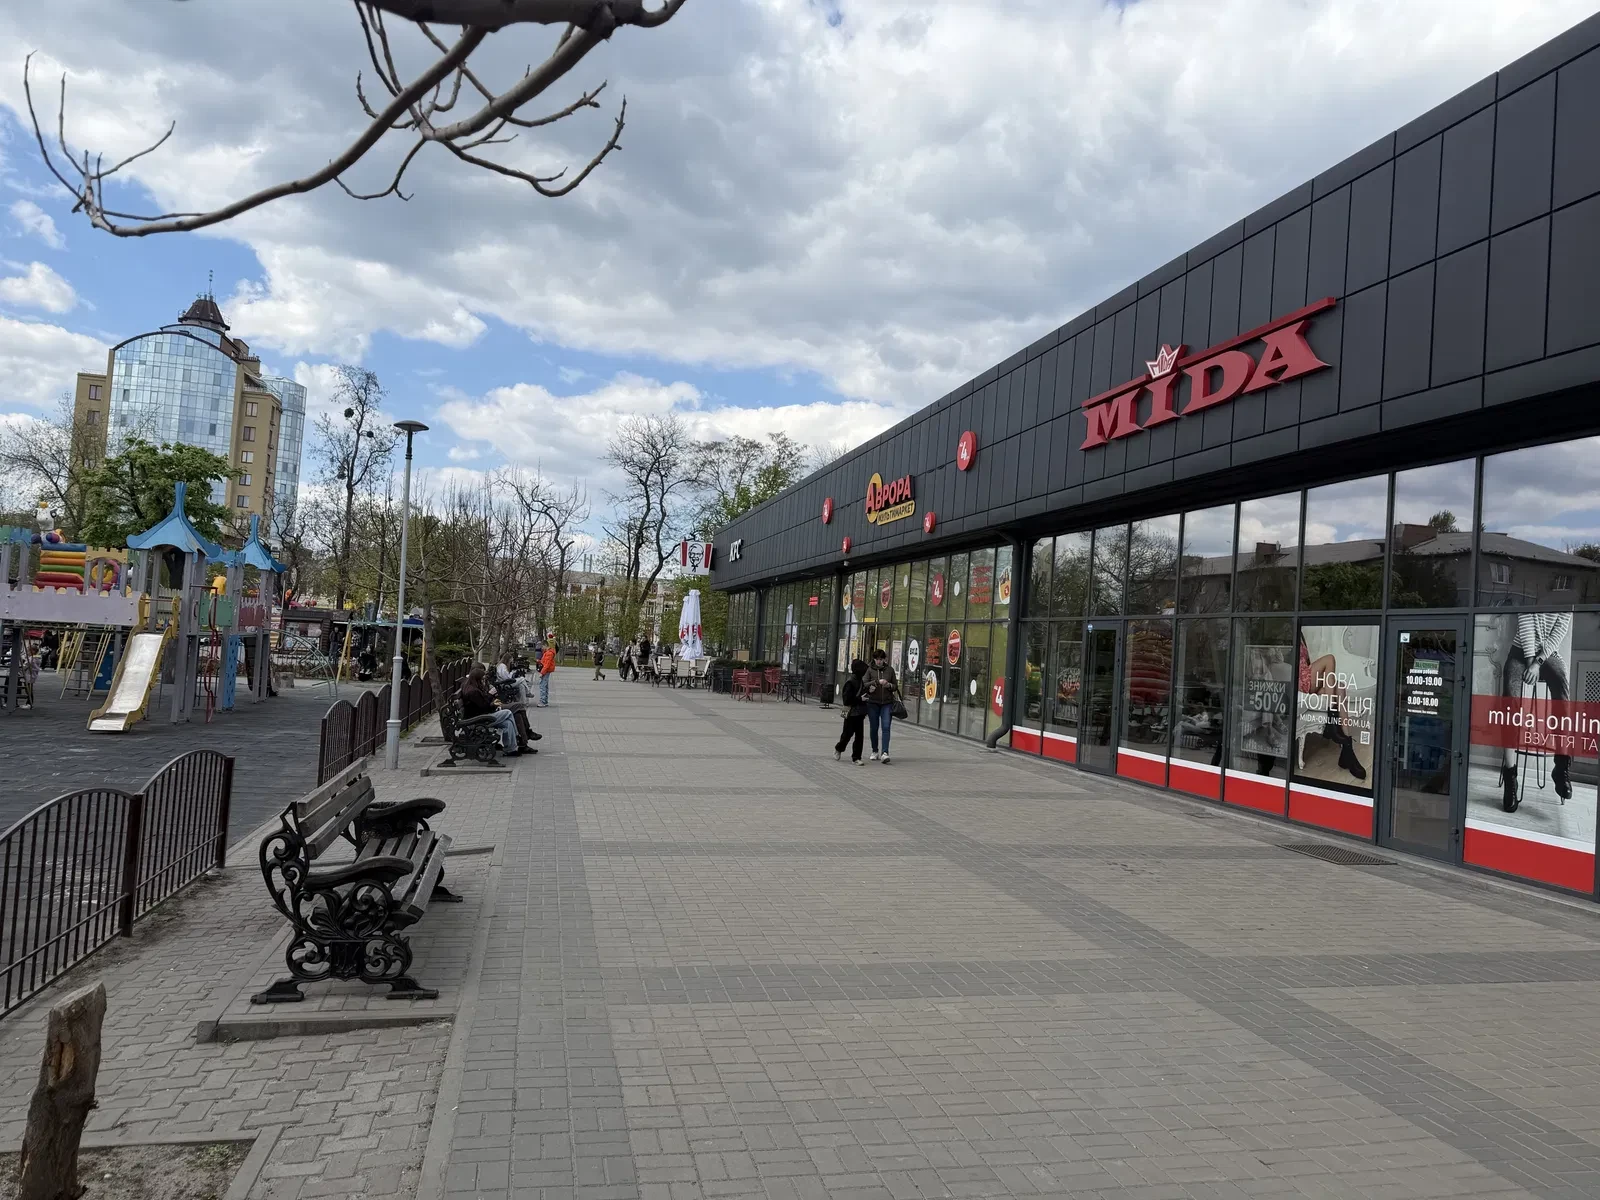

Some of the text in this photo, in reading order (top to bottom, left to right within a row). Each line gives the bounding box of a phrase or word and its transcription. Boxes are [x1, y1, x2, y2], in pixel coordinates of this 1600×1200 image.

[1079, 316, 1332, 451] MIDA
[865, 474, 912, 514] АВРОРА
[1248, 680, 1286, 693] ЗНИЖКИ
[1315, 671, 1358, 690] НОВА
[1406, 675, 1443, 687] 10.00-19.00
[1300, 693, 1373, 717] КОЛЕКЦІЯ
[1407, 695, 1439, 707] 9.00-18.00
[1299, 713, 1371, 730] MIDA-ONLINE.COM.UA
[1524, 731, 1599, 752] ВЗУТТЯ ТА
